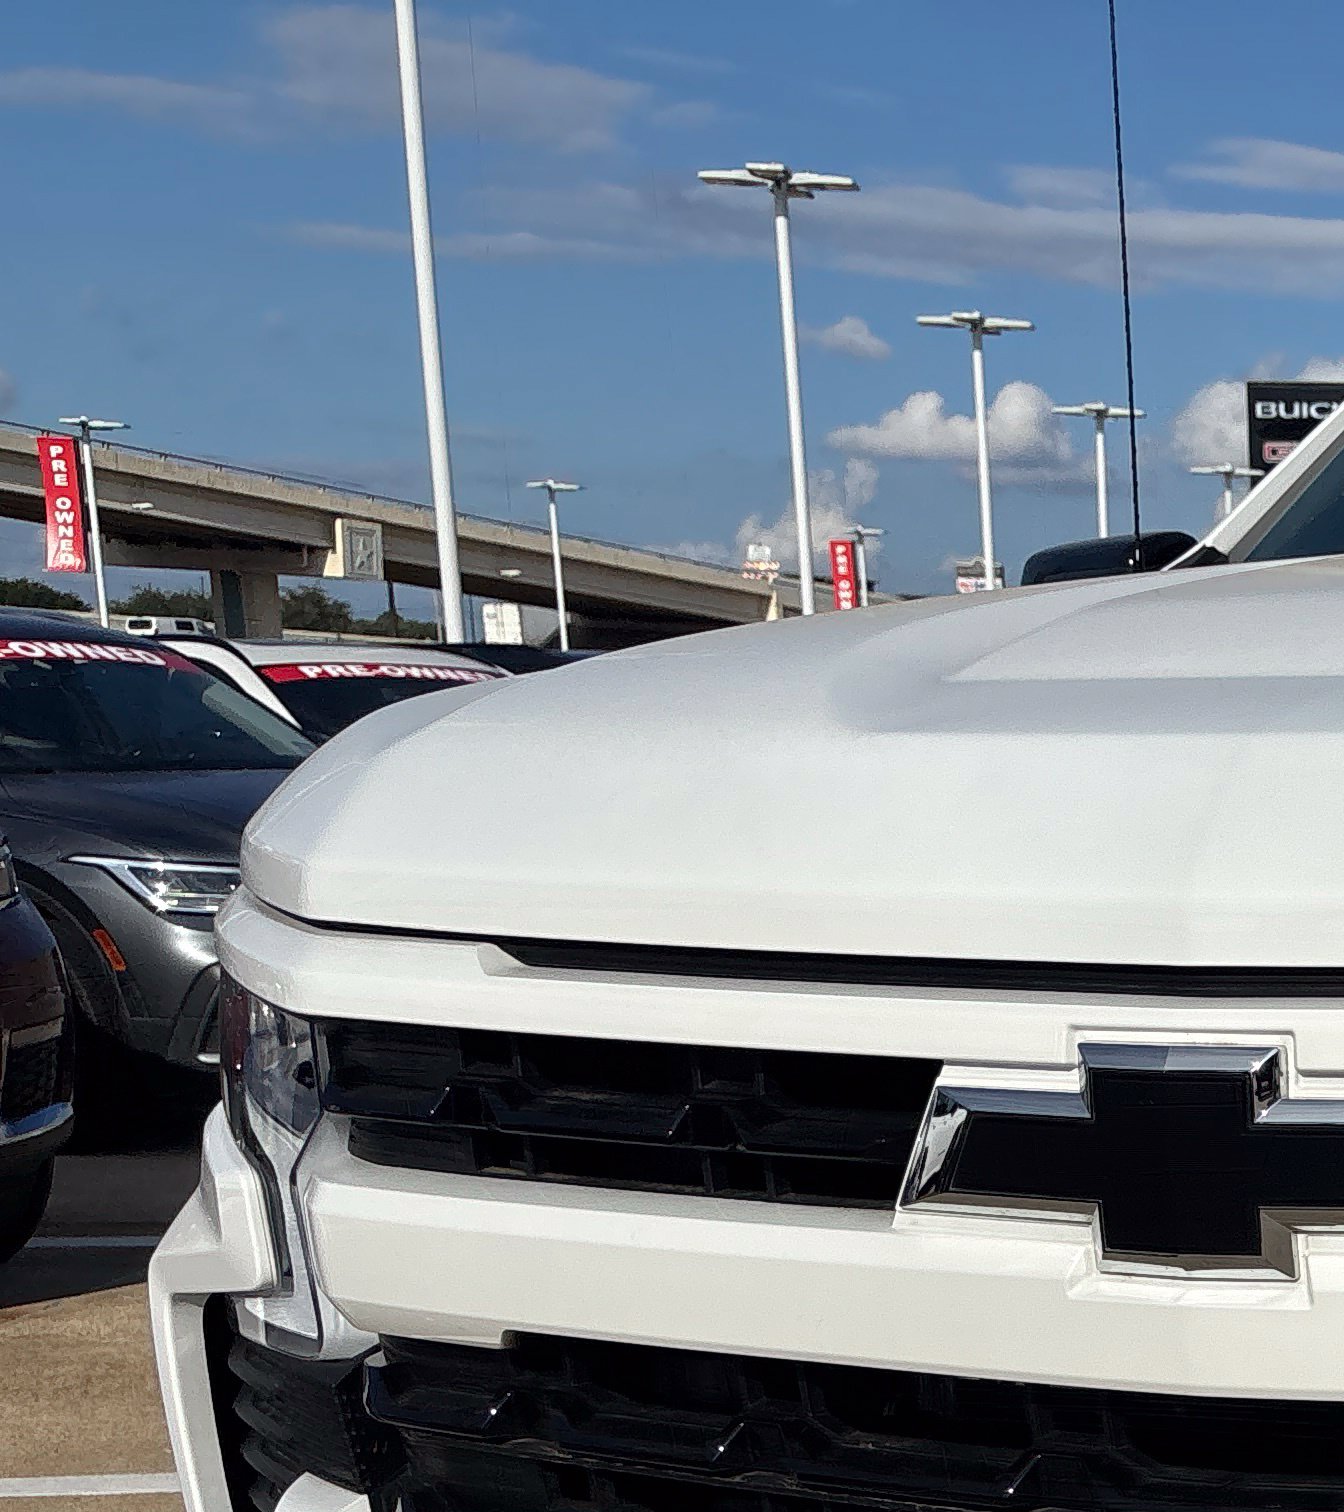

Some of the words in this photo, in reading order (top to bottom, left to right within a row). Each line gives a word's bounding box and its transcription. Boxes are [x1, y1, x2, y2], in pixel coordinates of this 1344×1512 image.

[1254, 401, 1339, 419] BUIC
[50, 445, 68, 487] PRE
[54, 497, 76, 565] OWNED
[0, 641, 167, 666] -OWNED
